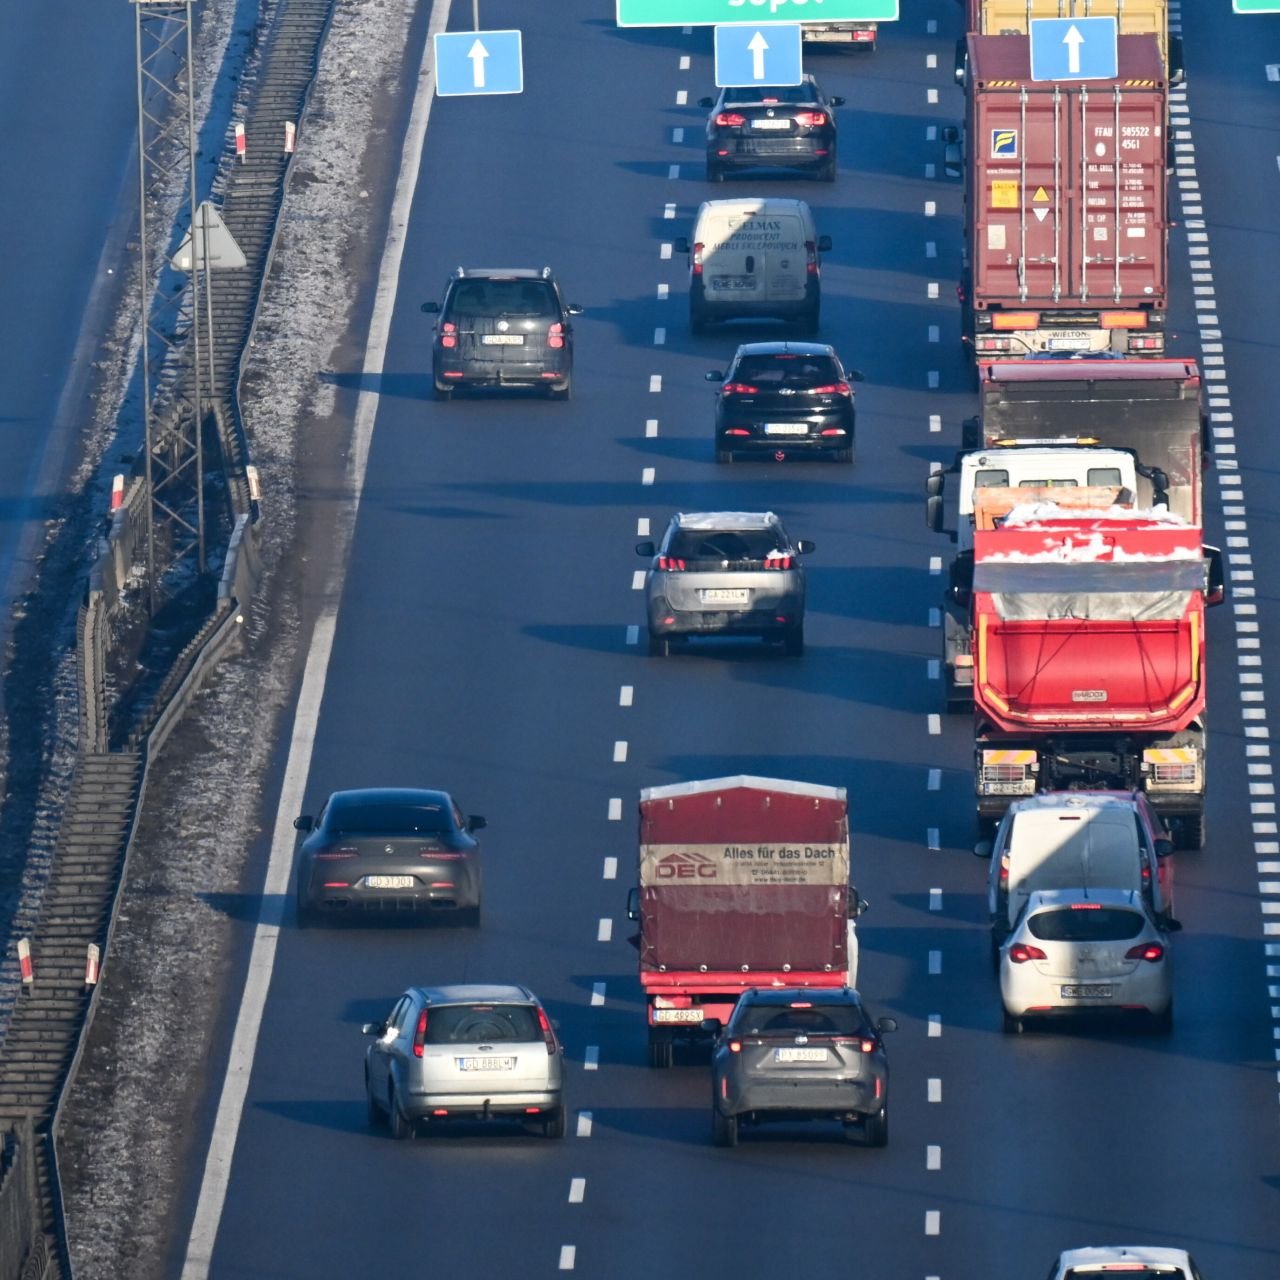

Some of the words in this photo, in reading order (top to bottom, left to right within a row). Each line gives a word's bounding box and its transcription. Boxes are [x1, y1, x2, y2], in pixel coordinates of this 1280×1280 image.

[723, 847, 754, 859] Alles
[757, 847, 775, 859] für
[778, 847, 801, 859] das
[804, 847, 835, 859] Dach
[656, 863, 717, 879] DEG
